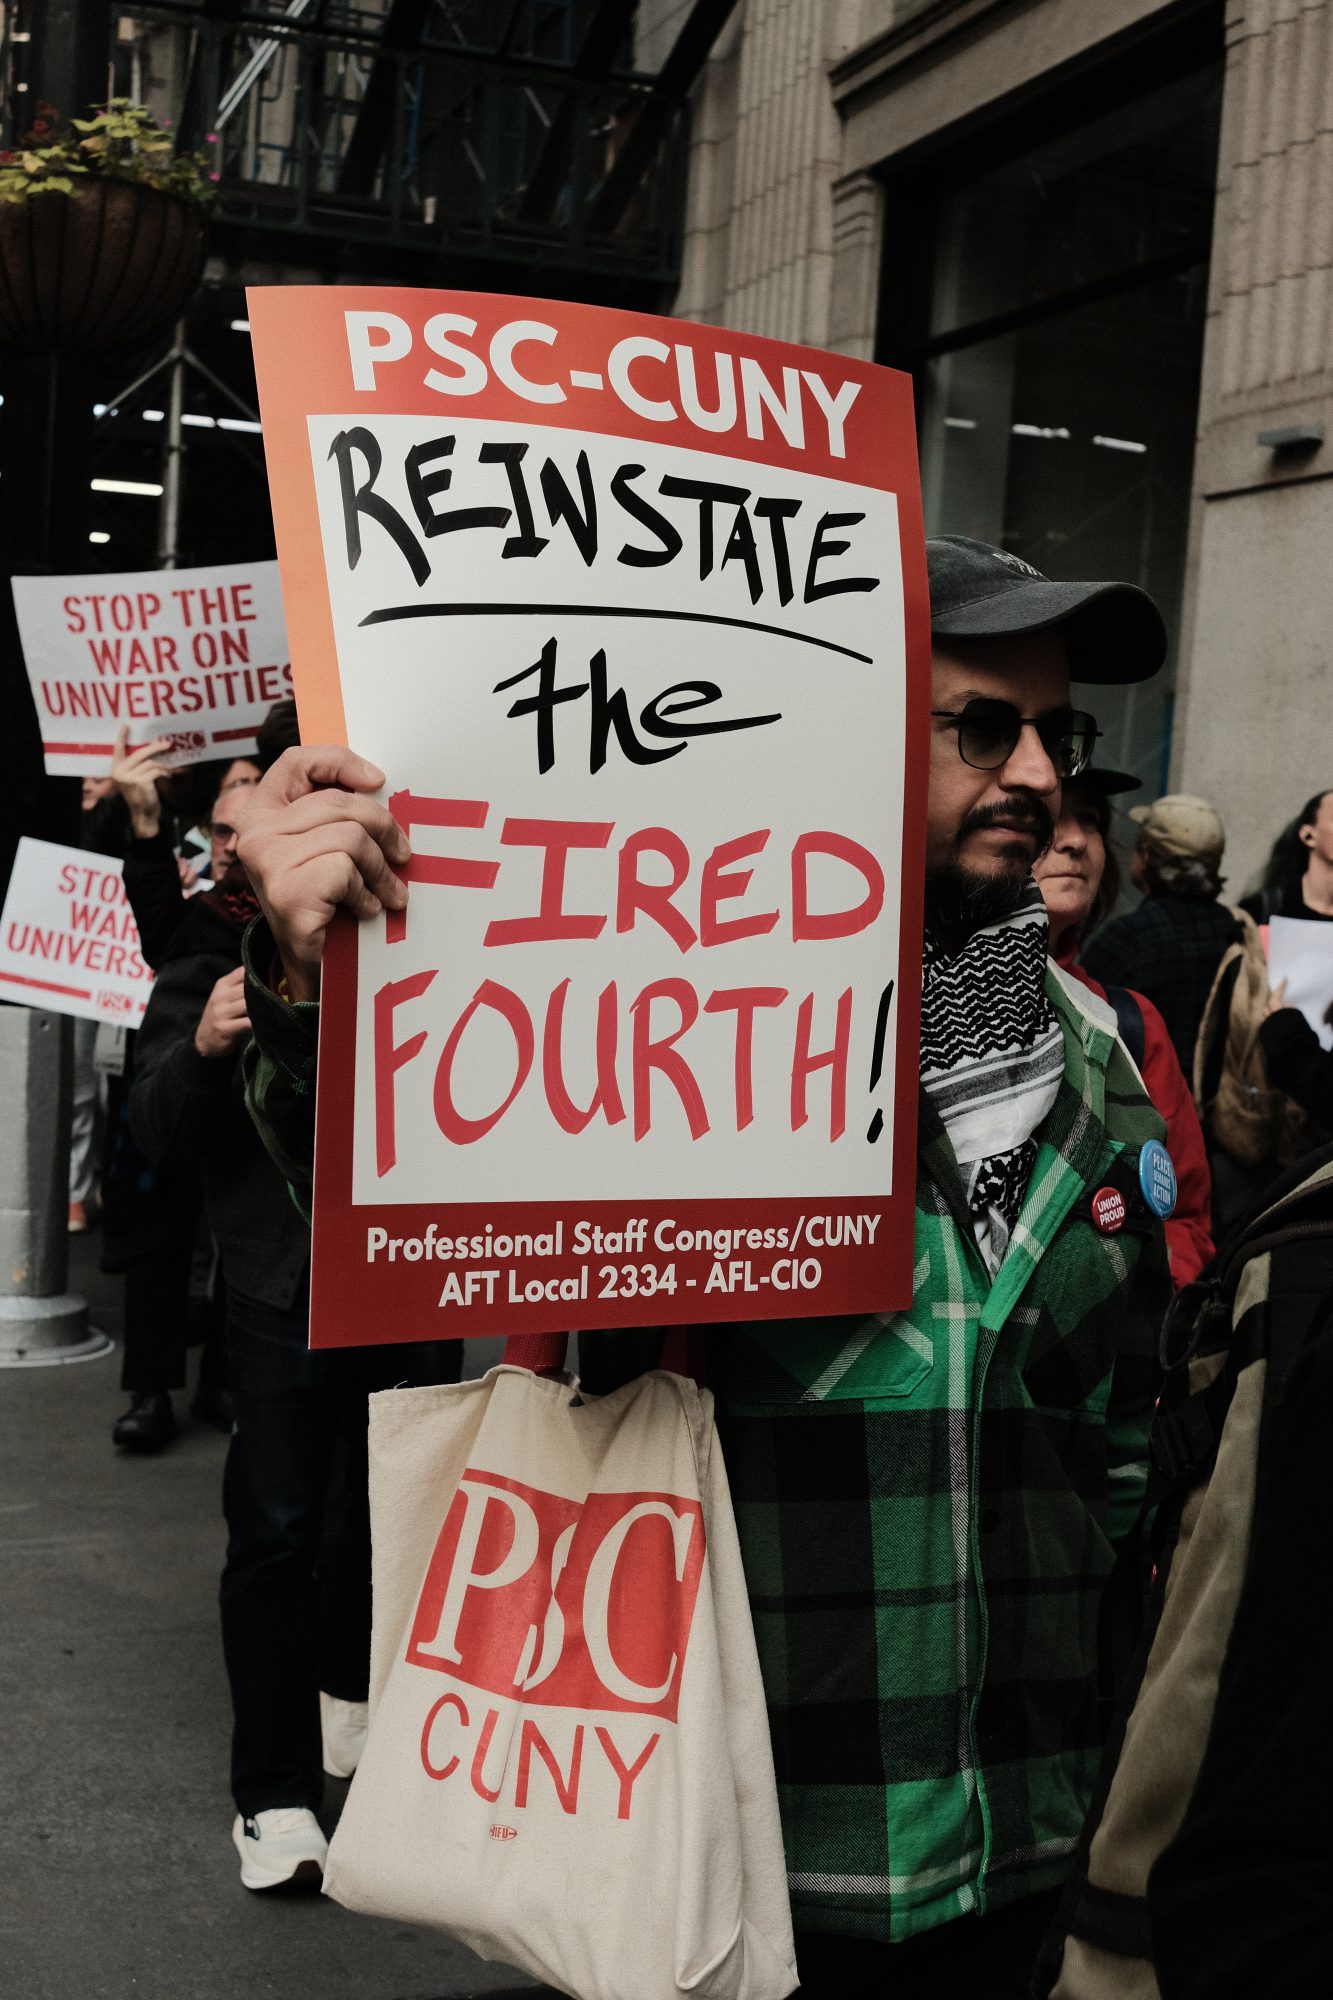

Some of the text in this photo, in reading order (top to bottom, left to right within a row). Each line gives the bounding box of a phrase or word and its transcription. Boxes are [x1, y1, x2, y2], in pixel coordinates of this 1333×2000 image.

[344, 310, 863, 460] PSC-CUNY
[327, 426, 881, 608] REINSTATE
[63, 584, 257, 634] STOP THE
[88, 628, 250, 676] WAR ON
[492, 636, 782, 775] the
[385, 788, 885, 954] FIRED
[373, 969, 894, 1178] FOURTH!
[367, 1214, 882, 1264] Professional Staff Congress/CUNY
[1097, 1194, 1122, 1213] UNION
[1100, 1206, 1125, 1226] PROUD
[1153, 1183, 1171, 1207] ACTION
[438, 1270, 500, 1308] AFT
[507, 1266, 589, 1302] Local
[598, 1265, 677, 1299] 2334
[704, 1258, 822, 1294] AFL-CIO
[416, 1479, 696, 1703] PSC
[420, 1693, 661, 1821] CUNY
